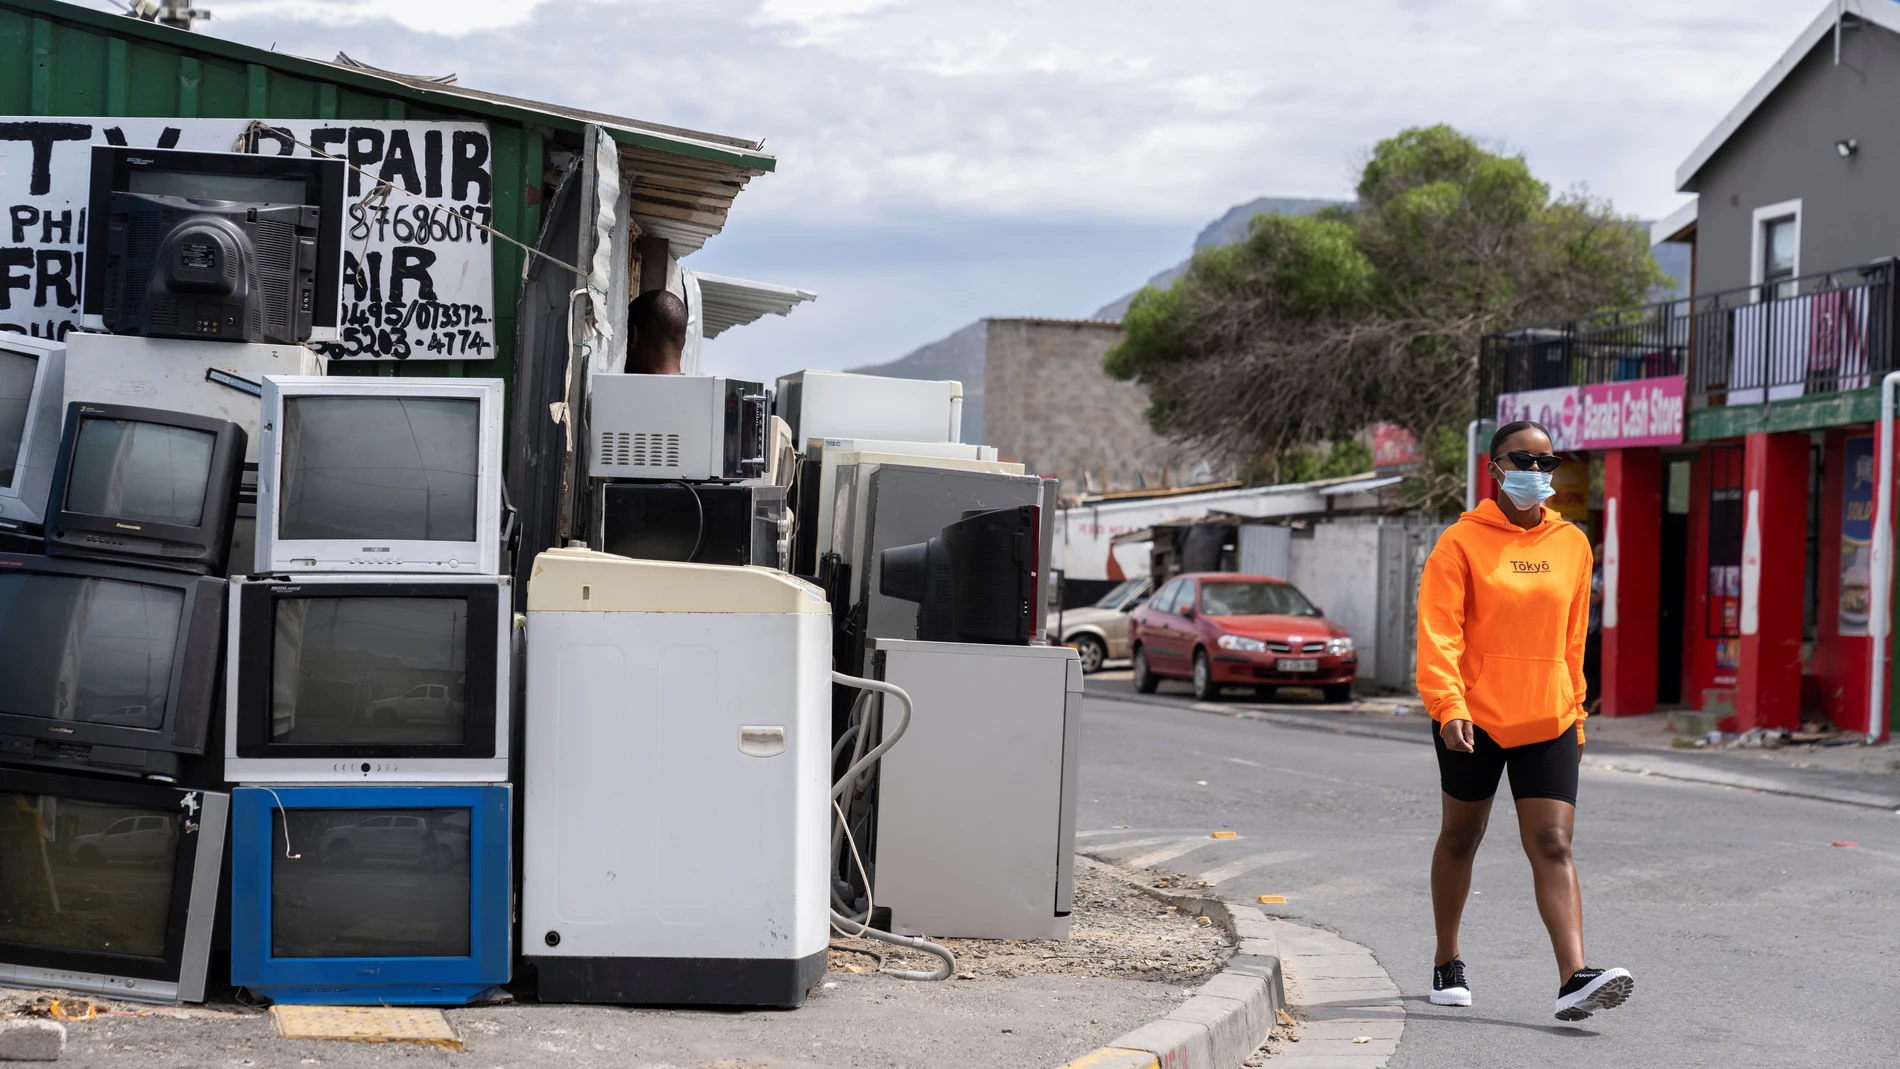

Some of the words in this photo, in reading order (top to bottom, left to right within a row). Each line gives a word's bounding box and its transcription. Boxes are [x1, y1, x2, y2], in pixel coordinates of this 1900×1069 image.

[0, 121, 182, 197] T
[10, 205, 86, 245] PH
[1584, 389, 1619, 440] Baraka
[1622, 386, 1648, 438] Cash
[1650, 386, 1682, 437] Store
